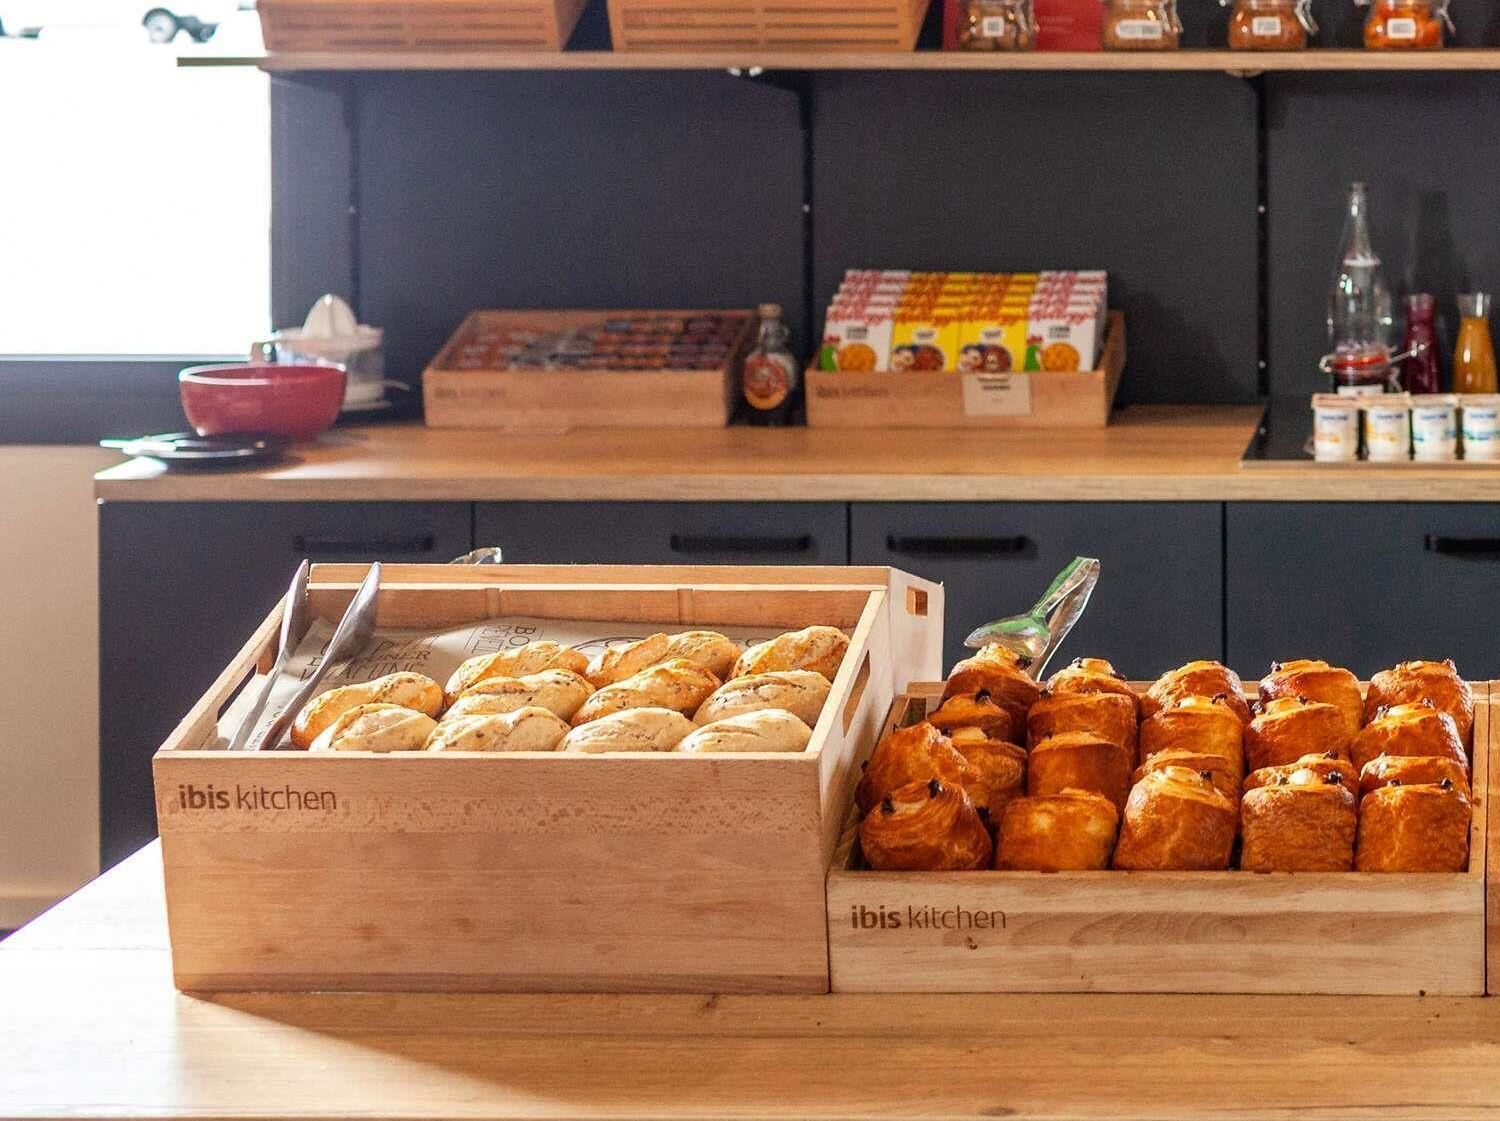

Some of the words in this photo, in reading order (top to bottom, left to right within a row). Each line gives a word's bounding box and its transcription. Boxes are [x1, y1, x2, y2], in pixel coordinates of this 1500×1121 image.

[179, 783, 231, 810] ibis
[236, 784, 338, 811] kitchen
[851, 904, 902, 930] ibis
[907, 904, 1008, 930] kitchen
